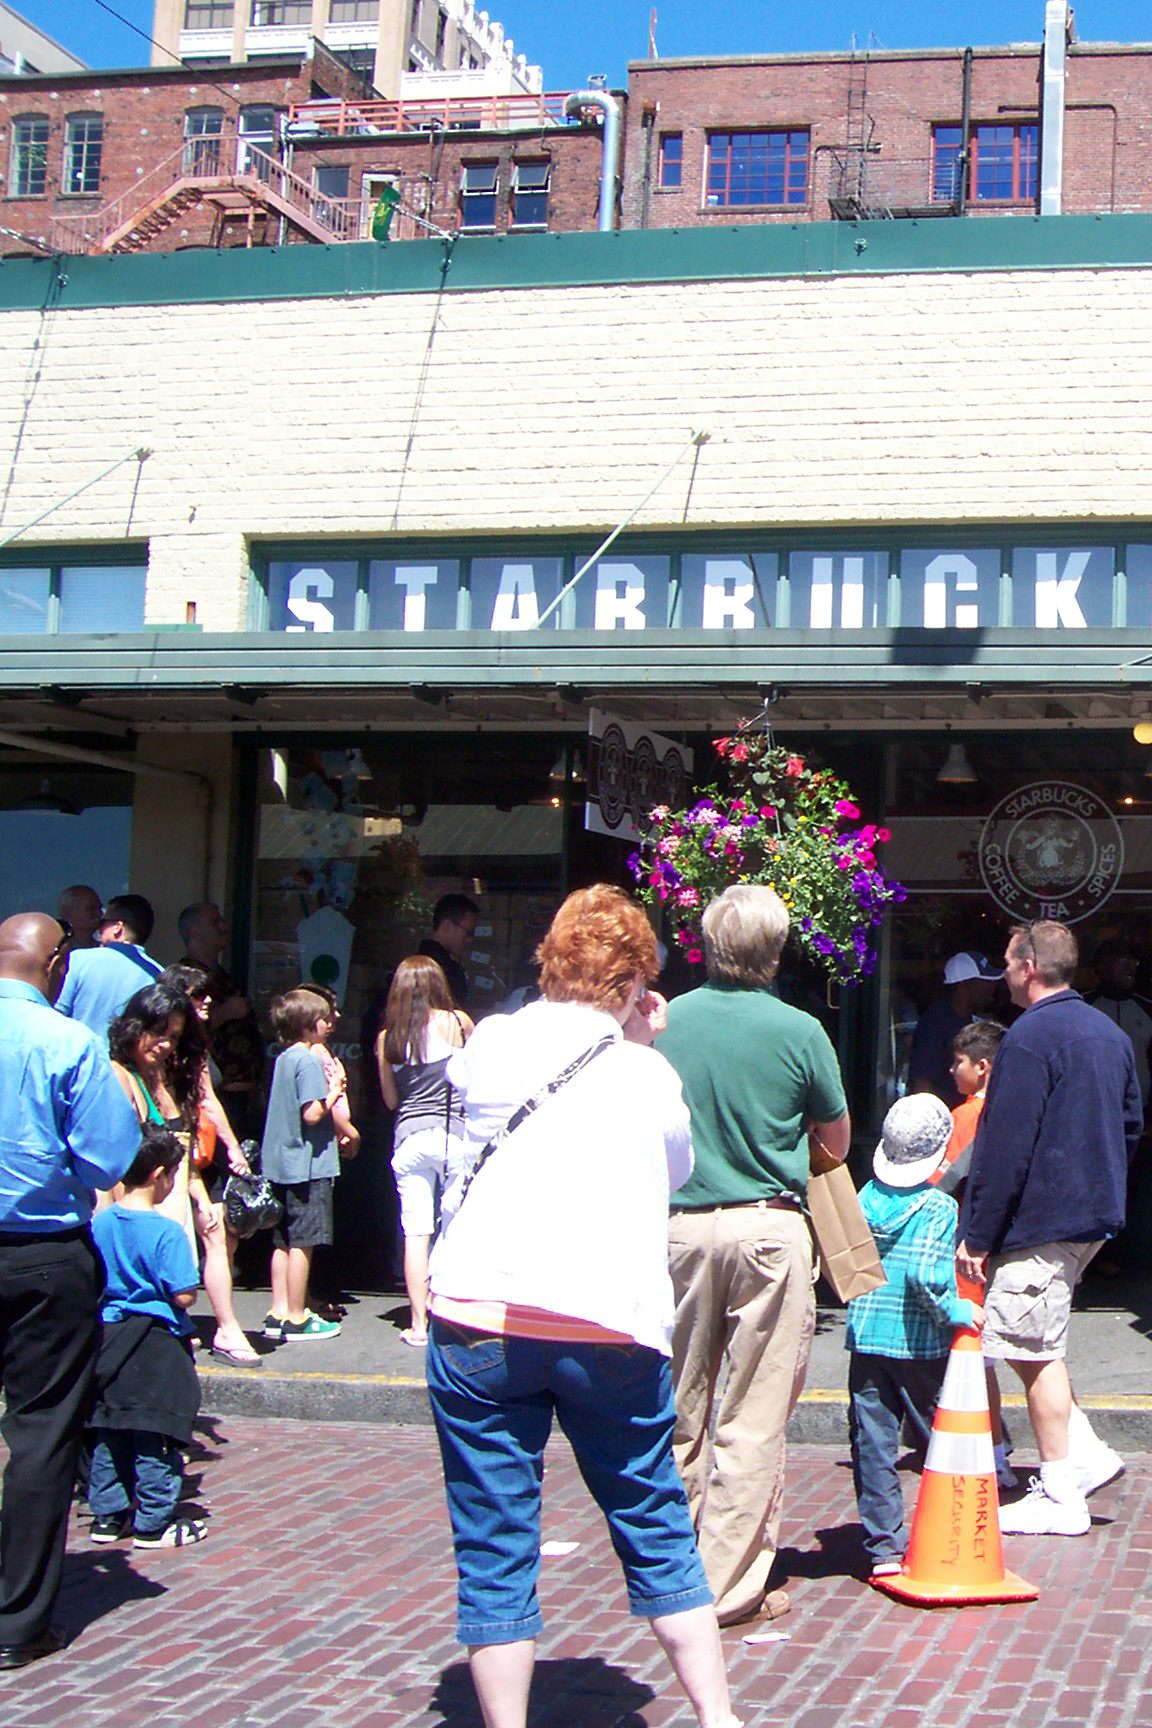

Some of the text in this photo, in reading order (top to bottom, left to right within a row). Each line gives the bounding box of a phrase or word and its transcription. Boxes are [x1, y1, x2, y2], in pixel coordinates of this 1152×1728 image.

[1005, 787, 1097, 818] STARBUCKS
[985, 843, 1020, 905] COFFEE
[1087, 843, 1116, 898] SPICES
[1039, 902, 1070, 919] TEA
[973, 1478, 989, 1563] MARKET
